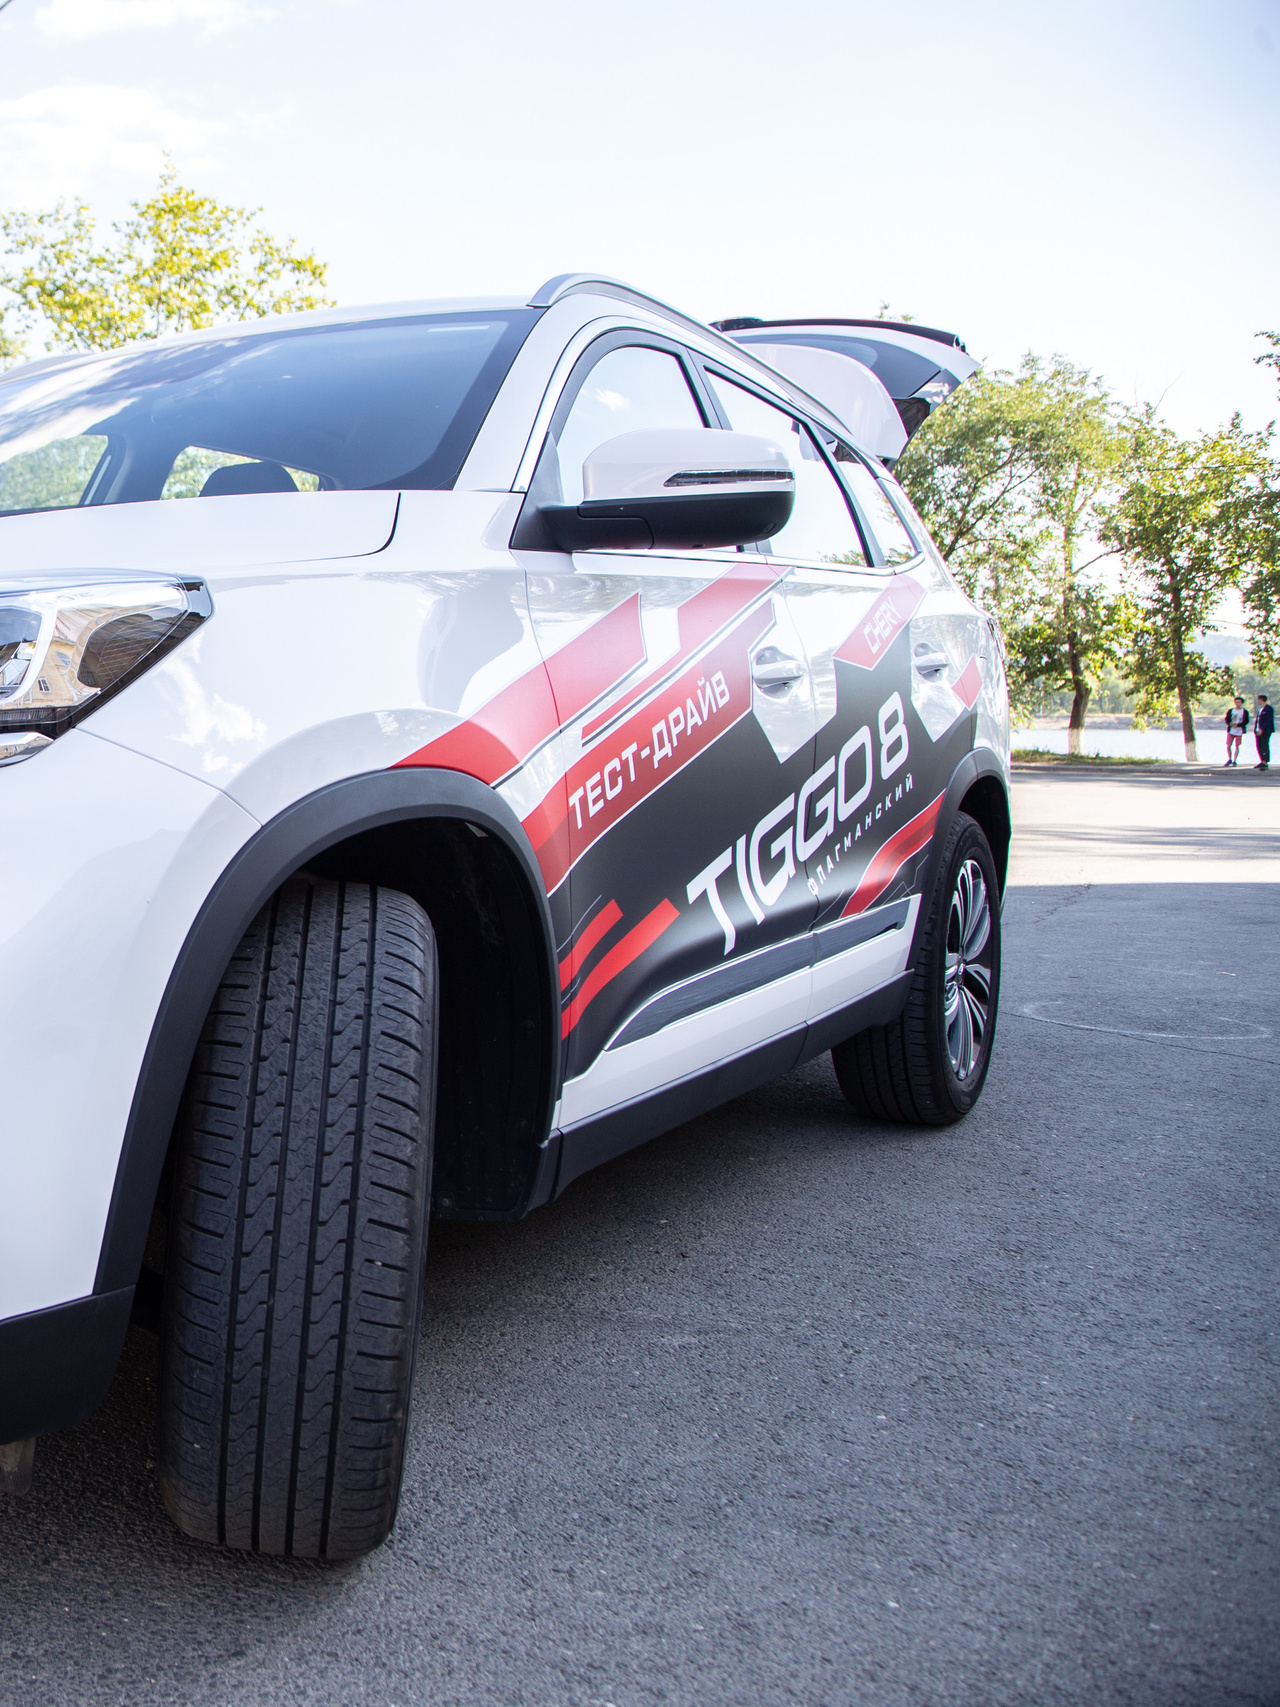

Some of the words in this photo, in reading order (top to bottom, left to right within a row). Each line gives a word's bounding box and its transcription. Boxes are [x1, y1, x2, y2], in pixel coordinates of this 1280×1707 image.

[862, 595, 902, 655] CHERY
[568, 670, 730, 830] ТЕСТ-ДРАЙВ
[686, 725, 873, 956] TIGGO
[878, 691, 910, 781] 8
